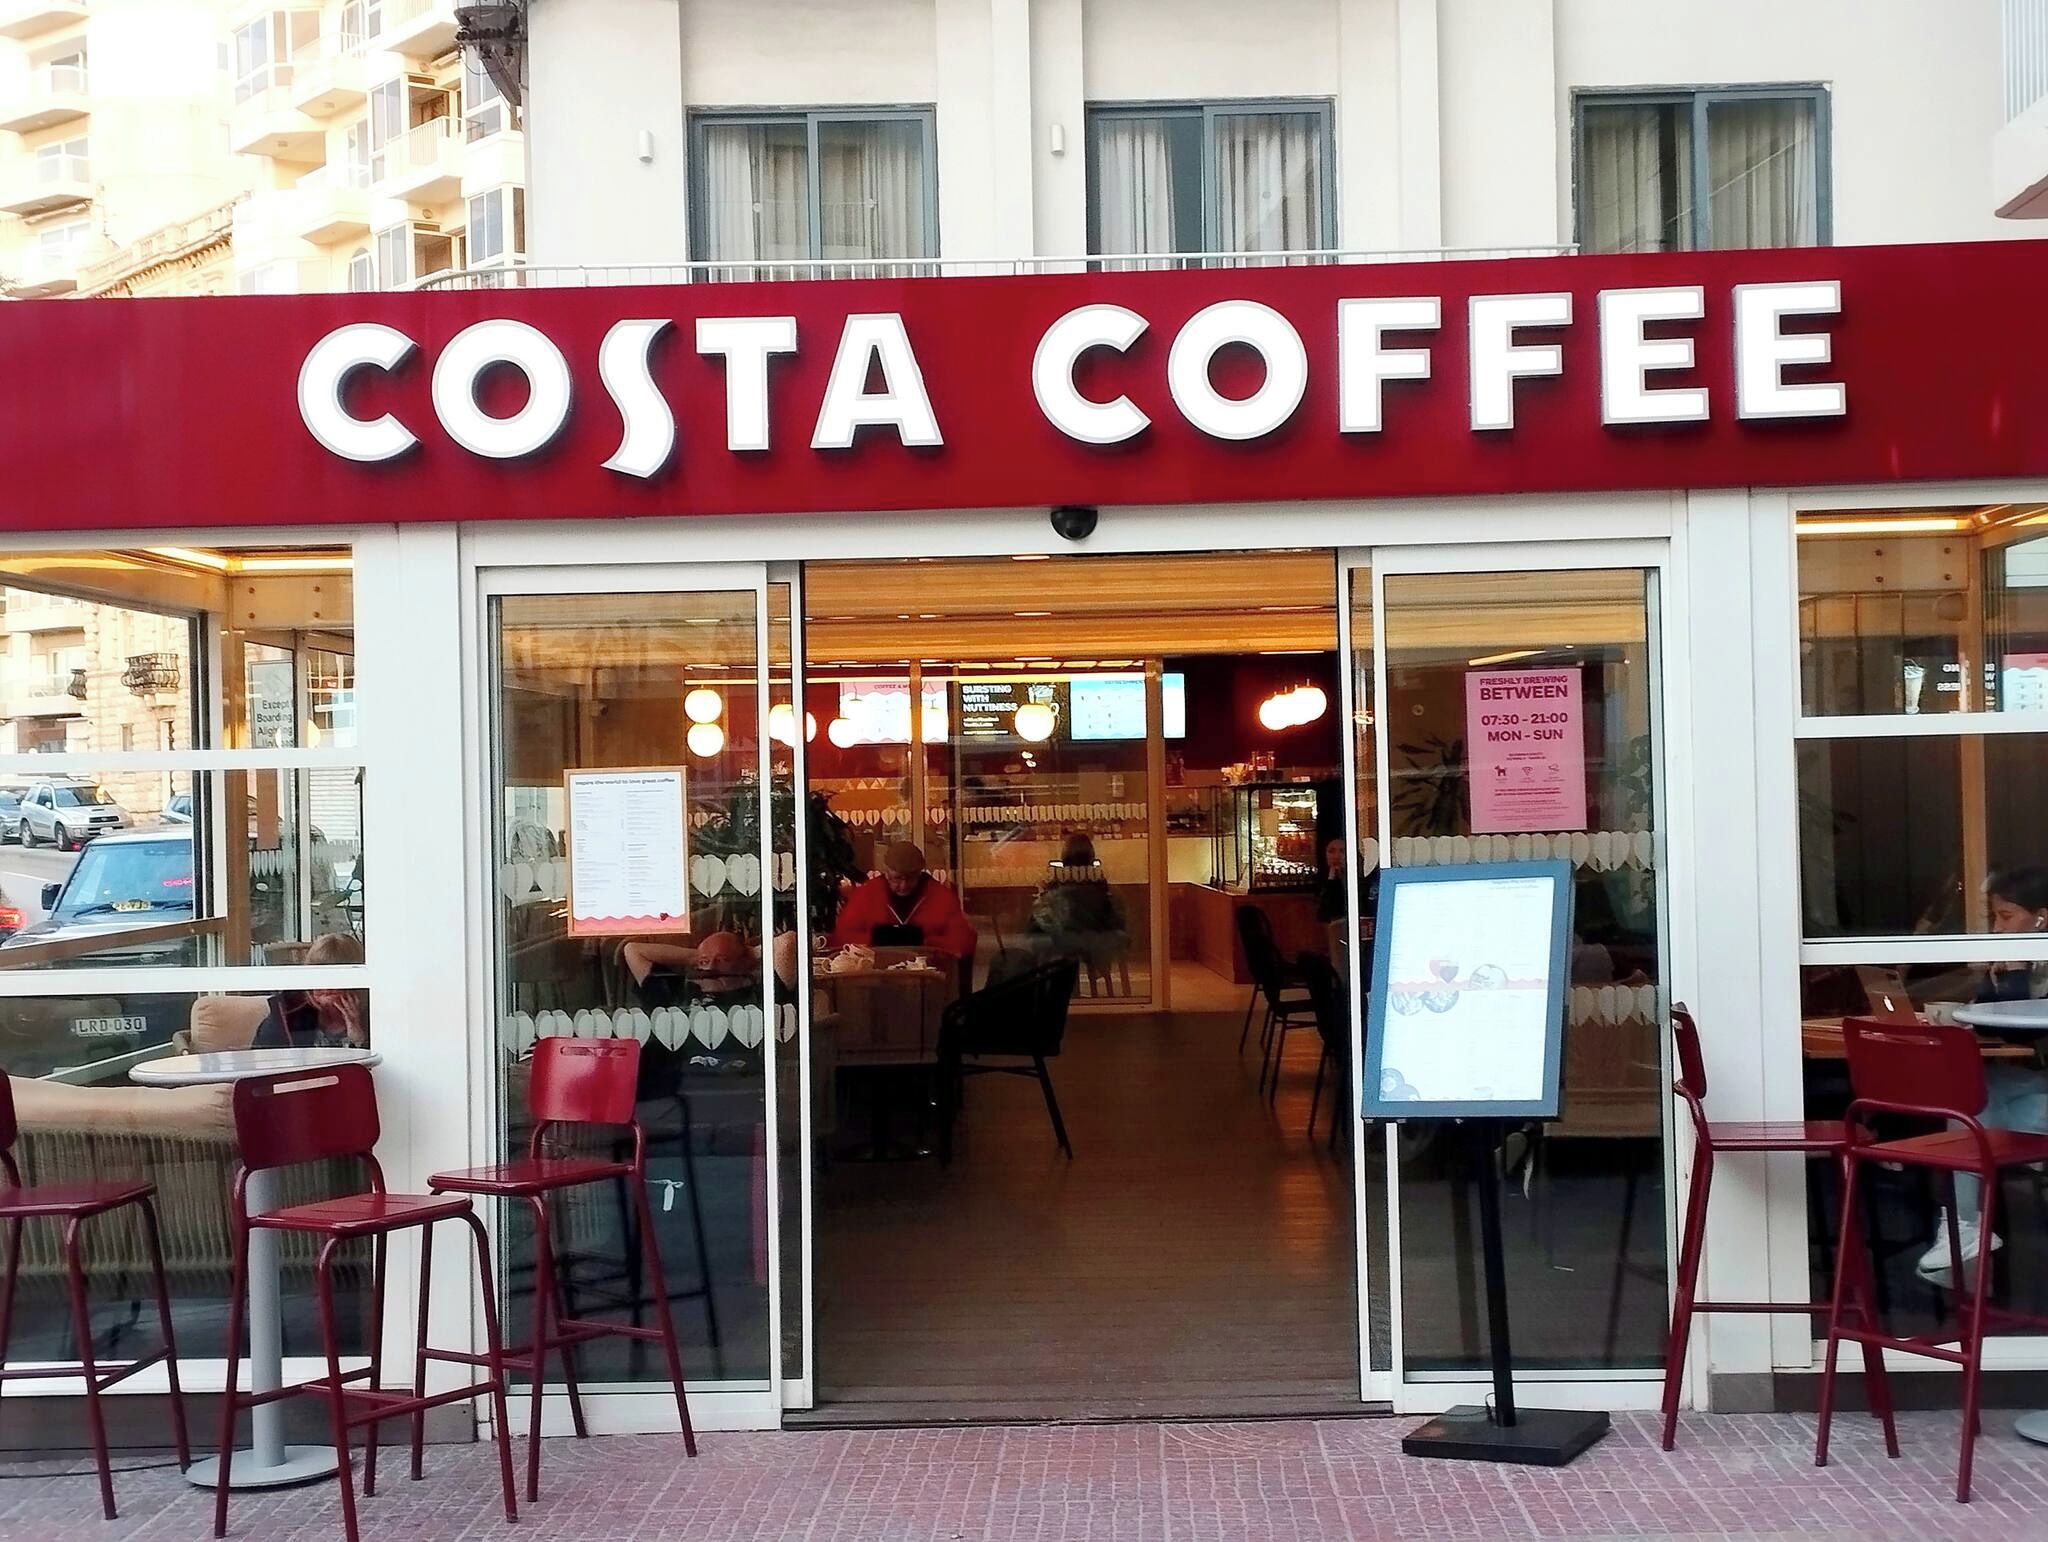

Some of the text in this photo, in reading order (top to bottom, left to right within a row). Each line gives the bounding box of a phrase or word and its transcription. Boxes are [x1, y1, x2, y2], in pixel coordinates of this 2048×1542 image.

[297, 280, 1847, 478] COSTA COFFEE
[1480, 675, 1568, 686] FRESHLY BREWING
[962, 684, 1012, 694] BURSTING
[1480, 685, 1568, 700] BETWEEN
[962, 694, 990, 702] WITH
[262, 700, 290, 710] Except
[963, 702, 1018, 712] NUTTINESS
[256, 712, 292, 723] Boarding
[1481, 714, 1519, 726] 07:30
[1530, 712, 1568, 724] 21:00
[1487, 730, 1522, 742] MON
[1533, 729, 1563, 740] SUN
[79, 1020, 108, 1032] LRD
